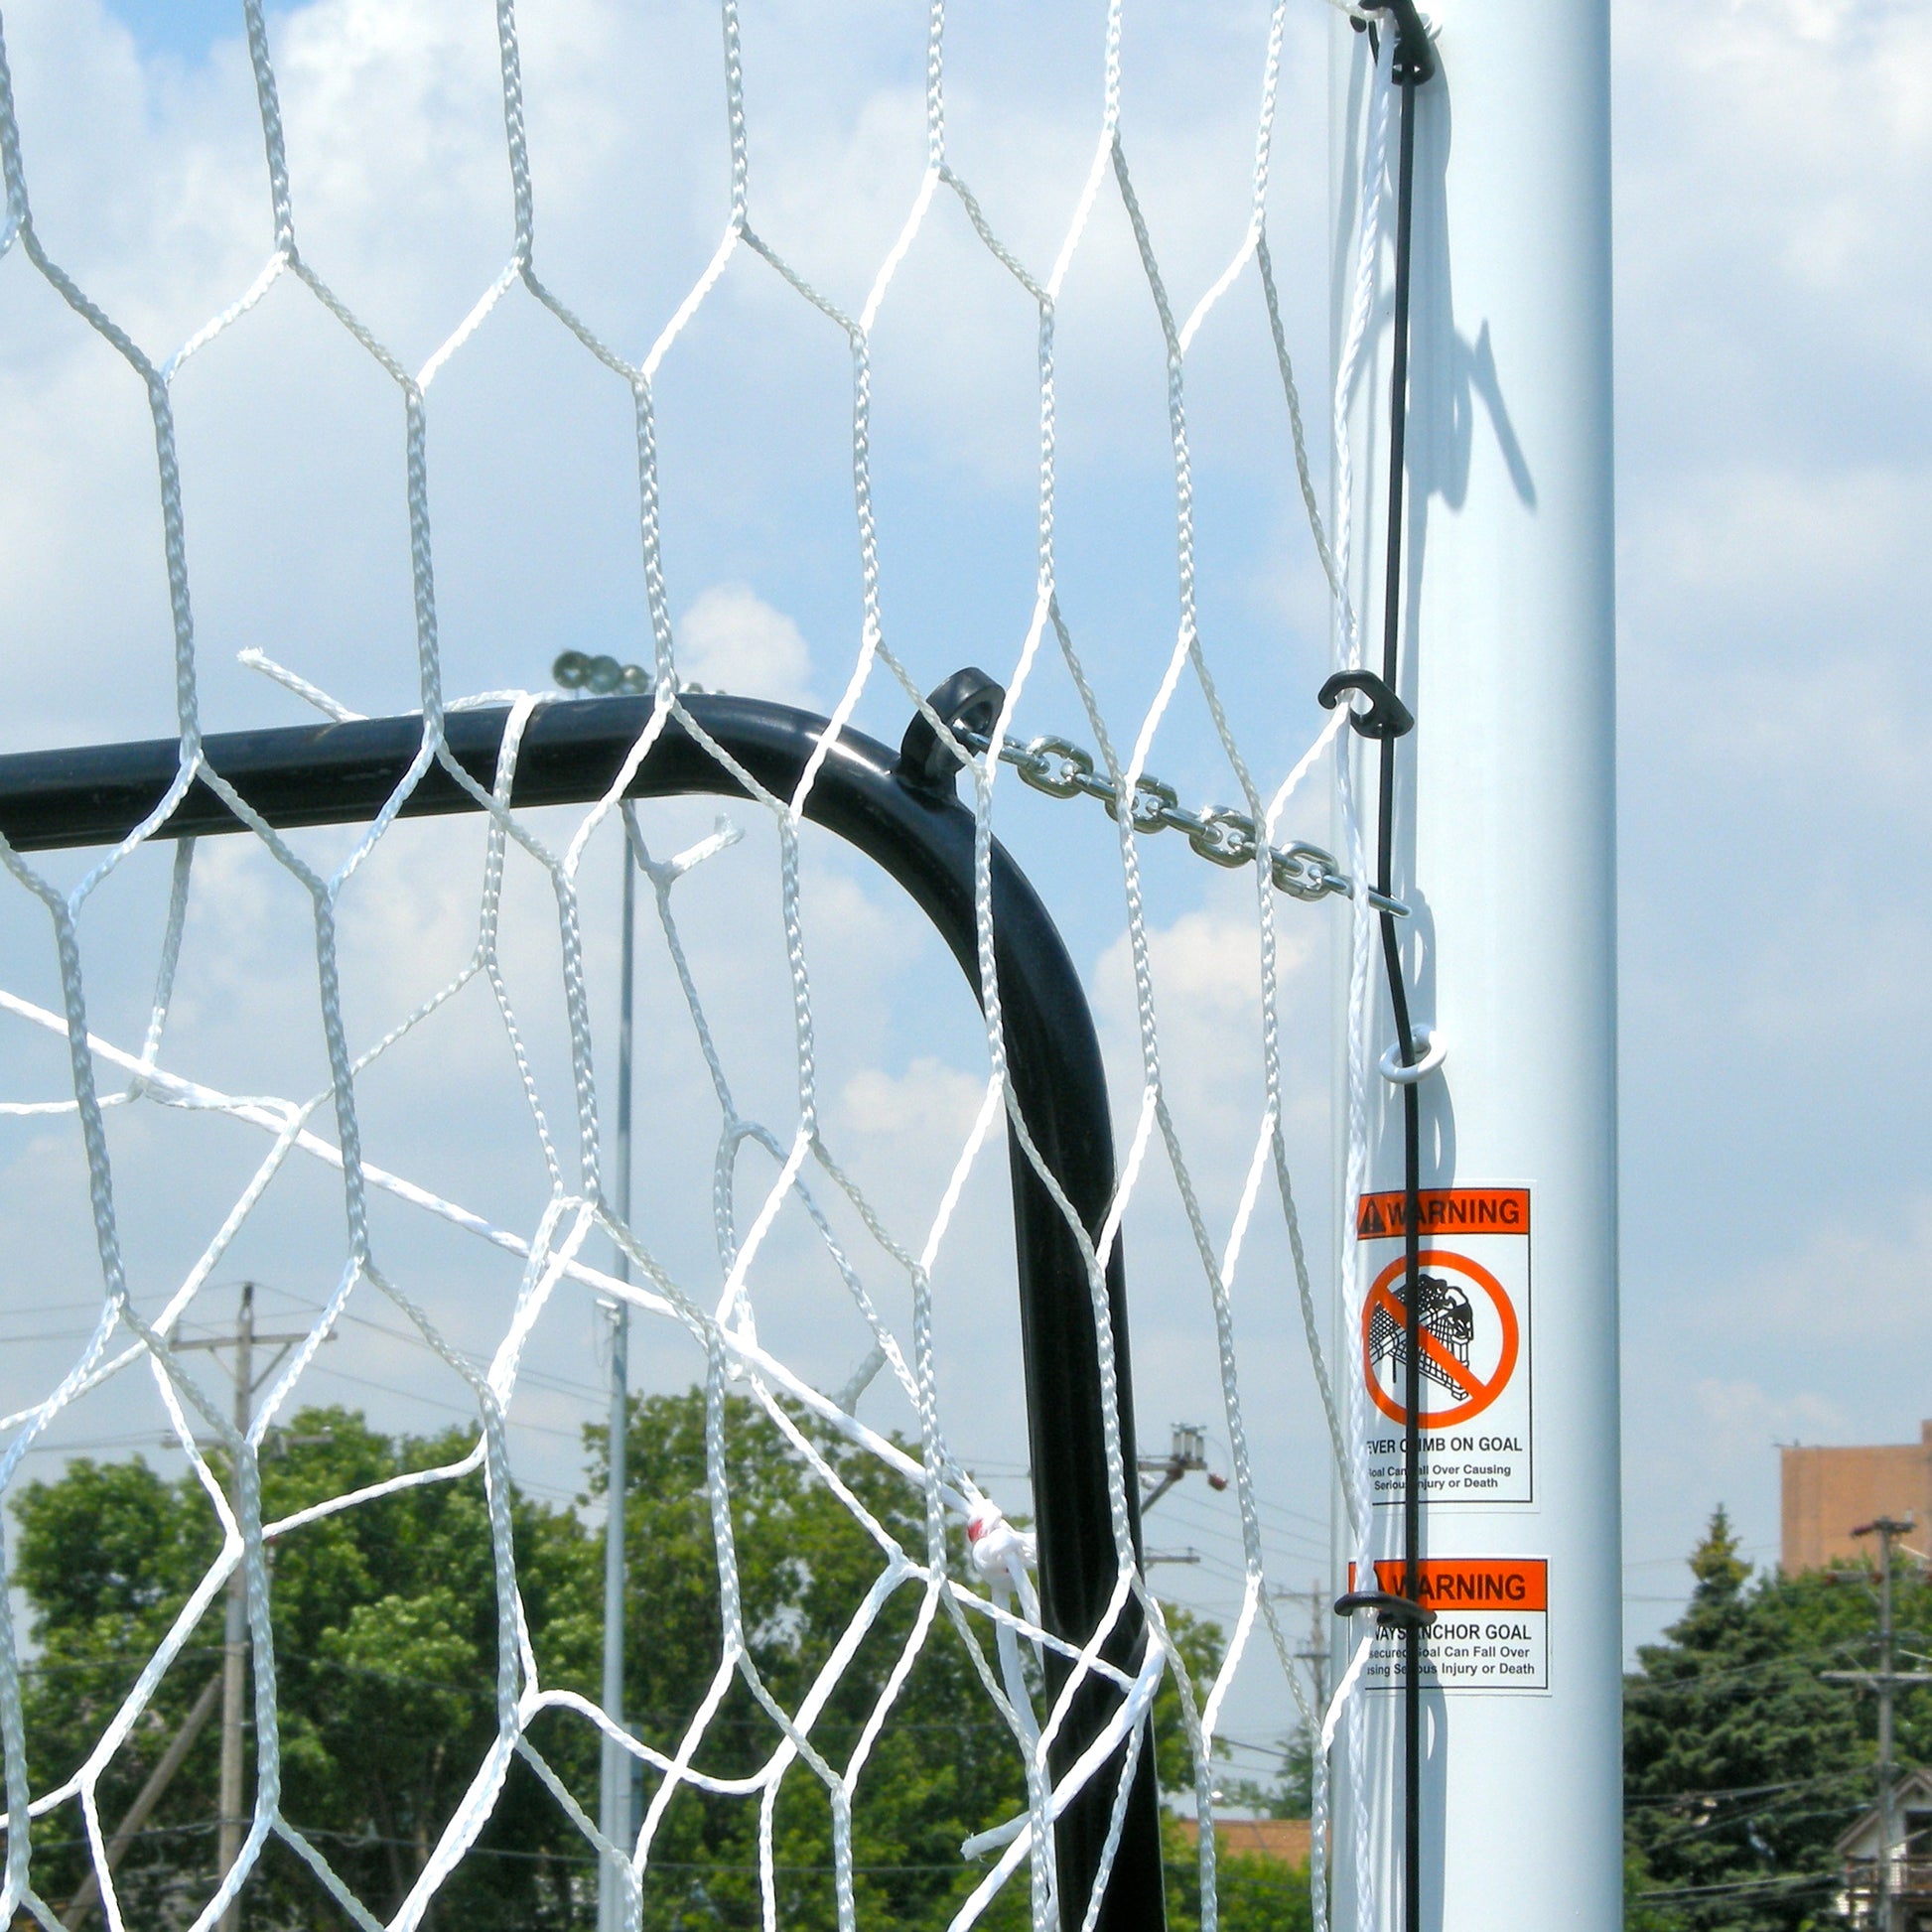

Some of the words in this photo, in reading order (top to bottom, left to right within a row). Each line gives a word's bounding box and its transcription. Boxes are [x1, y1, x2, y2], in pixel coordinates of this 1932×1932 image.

[1366, 1440, 1396, 1454] EVER
[1400, 1438, 1446, 1452] CIMB
[1450, 1437, 1473, 1451] ON
[1478, 1437, 1523, 1451] GOAL
[1369, 1466, 1385, 1477] oal
[1432, 1464, 1460, 1475] Over
[1462, 1463, 1511, 1477] Causing
[1374, 1479, 1407, 1490] Seriou
[1417, 1478, 1446, 1490] njury
[1448, 1479, 1460, 1488] or
[1463, 1477, 1498, 1488] Death
[1419, 1623, 1480, 1640] NCHOR
[1485, 1623, 1532, 1640] GOAL
[1444, 1646, 1469, 1658] Can
[1473, 1646, 1496, 1658] Fall
[1500, 1646, 1530, 1658] Over
[1442, 1662, 1478, 1677] Injury
[1481, 1664, 1496, 1674] or
[1499, 1662, 1535, 1675] Death
